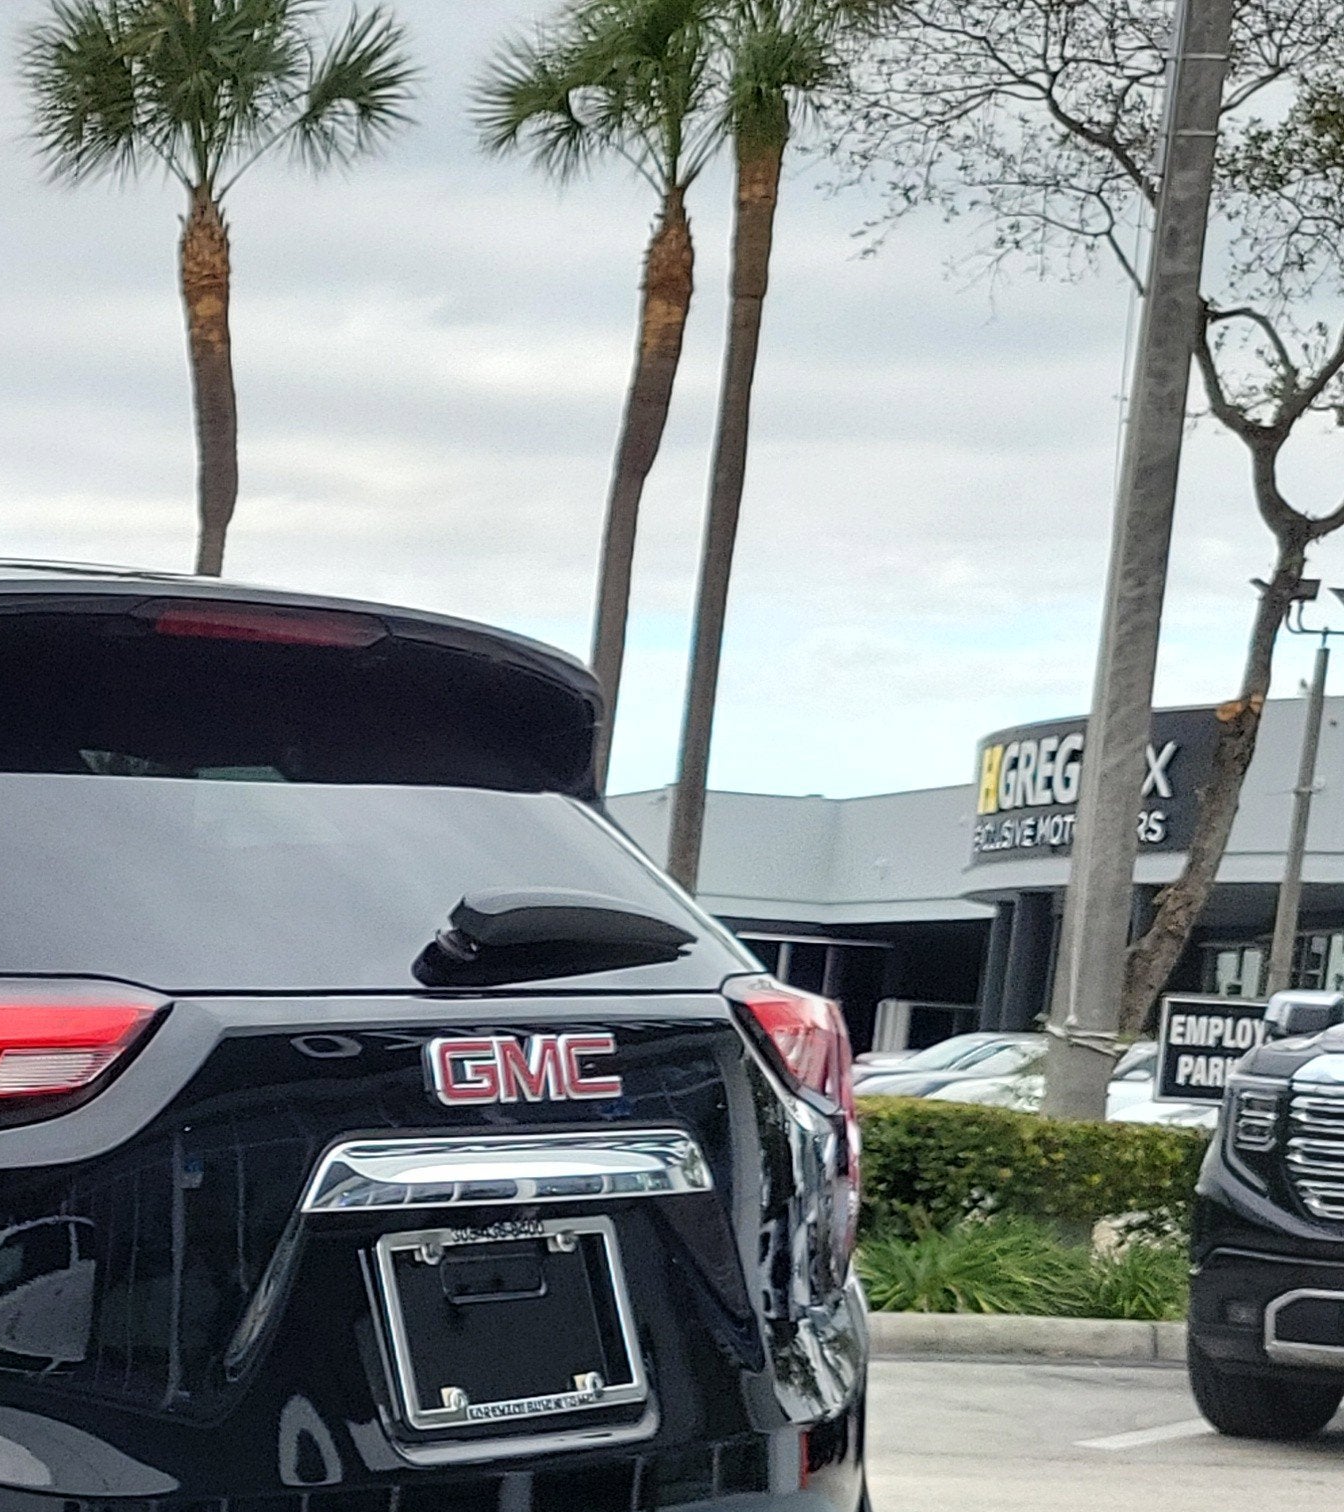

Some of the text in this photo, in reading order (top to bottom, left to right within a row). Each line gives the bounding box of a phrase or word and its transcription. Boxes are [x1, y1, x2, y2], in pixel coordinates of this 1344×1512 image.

[977, 734, 1177, 815] HGREGX
[1037, 810, 1167, 847] MOTRS
[1169, 1014, 1272, 1050] EMPLOY
[428, 1032, 623, 1107] GMC
